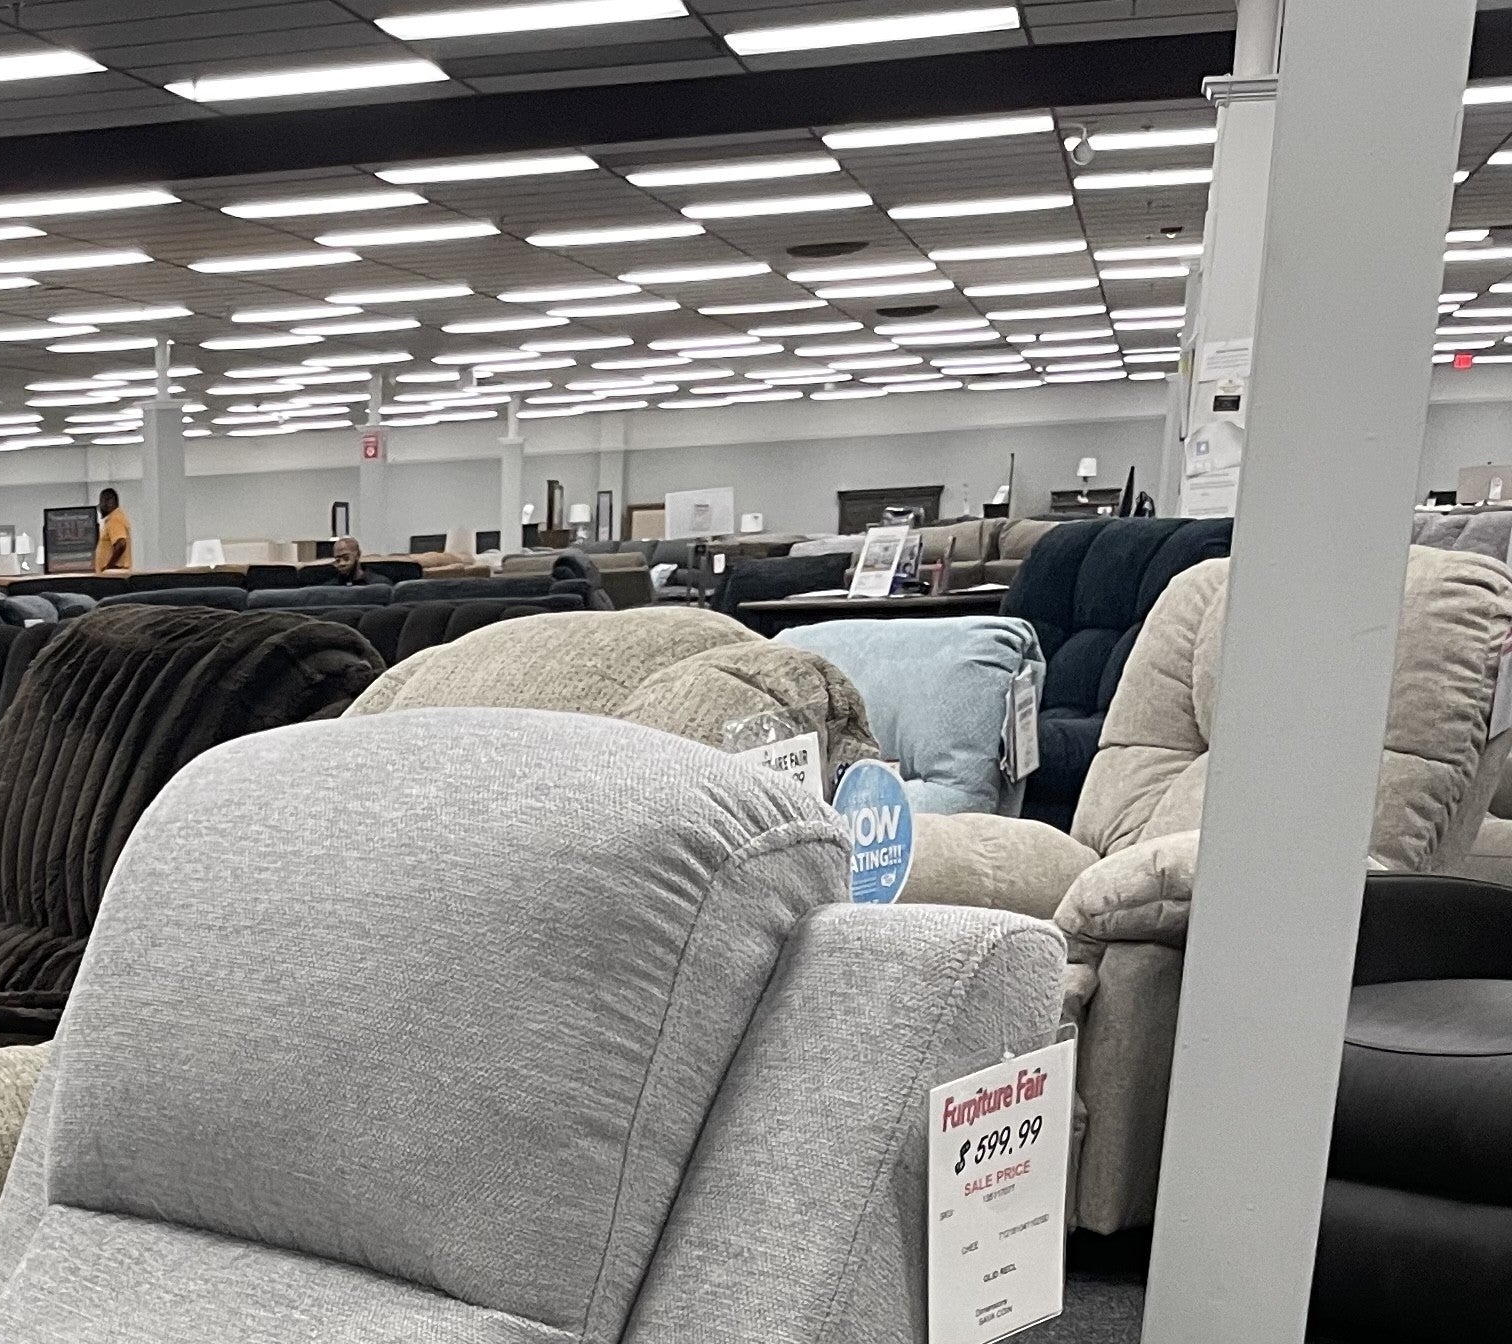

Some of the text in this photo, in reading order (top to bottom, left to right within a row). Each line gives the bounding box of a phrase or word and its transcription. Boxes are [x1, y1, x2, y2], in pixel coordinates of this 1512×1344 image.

[942, 1067, 1047, 1133] Furniture Fair
[964, 1173, 993, 1197] SALE
[996, 1159, 1031, 1184] PRICE
